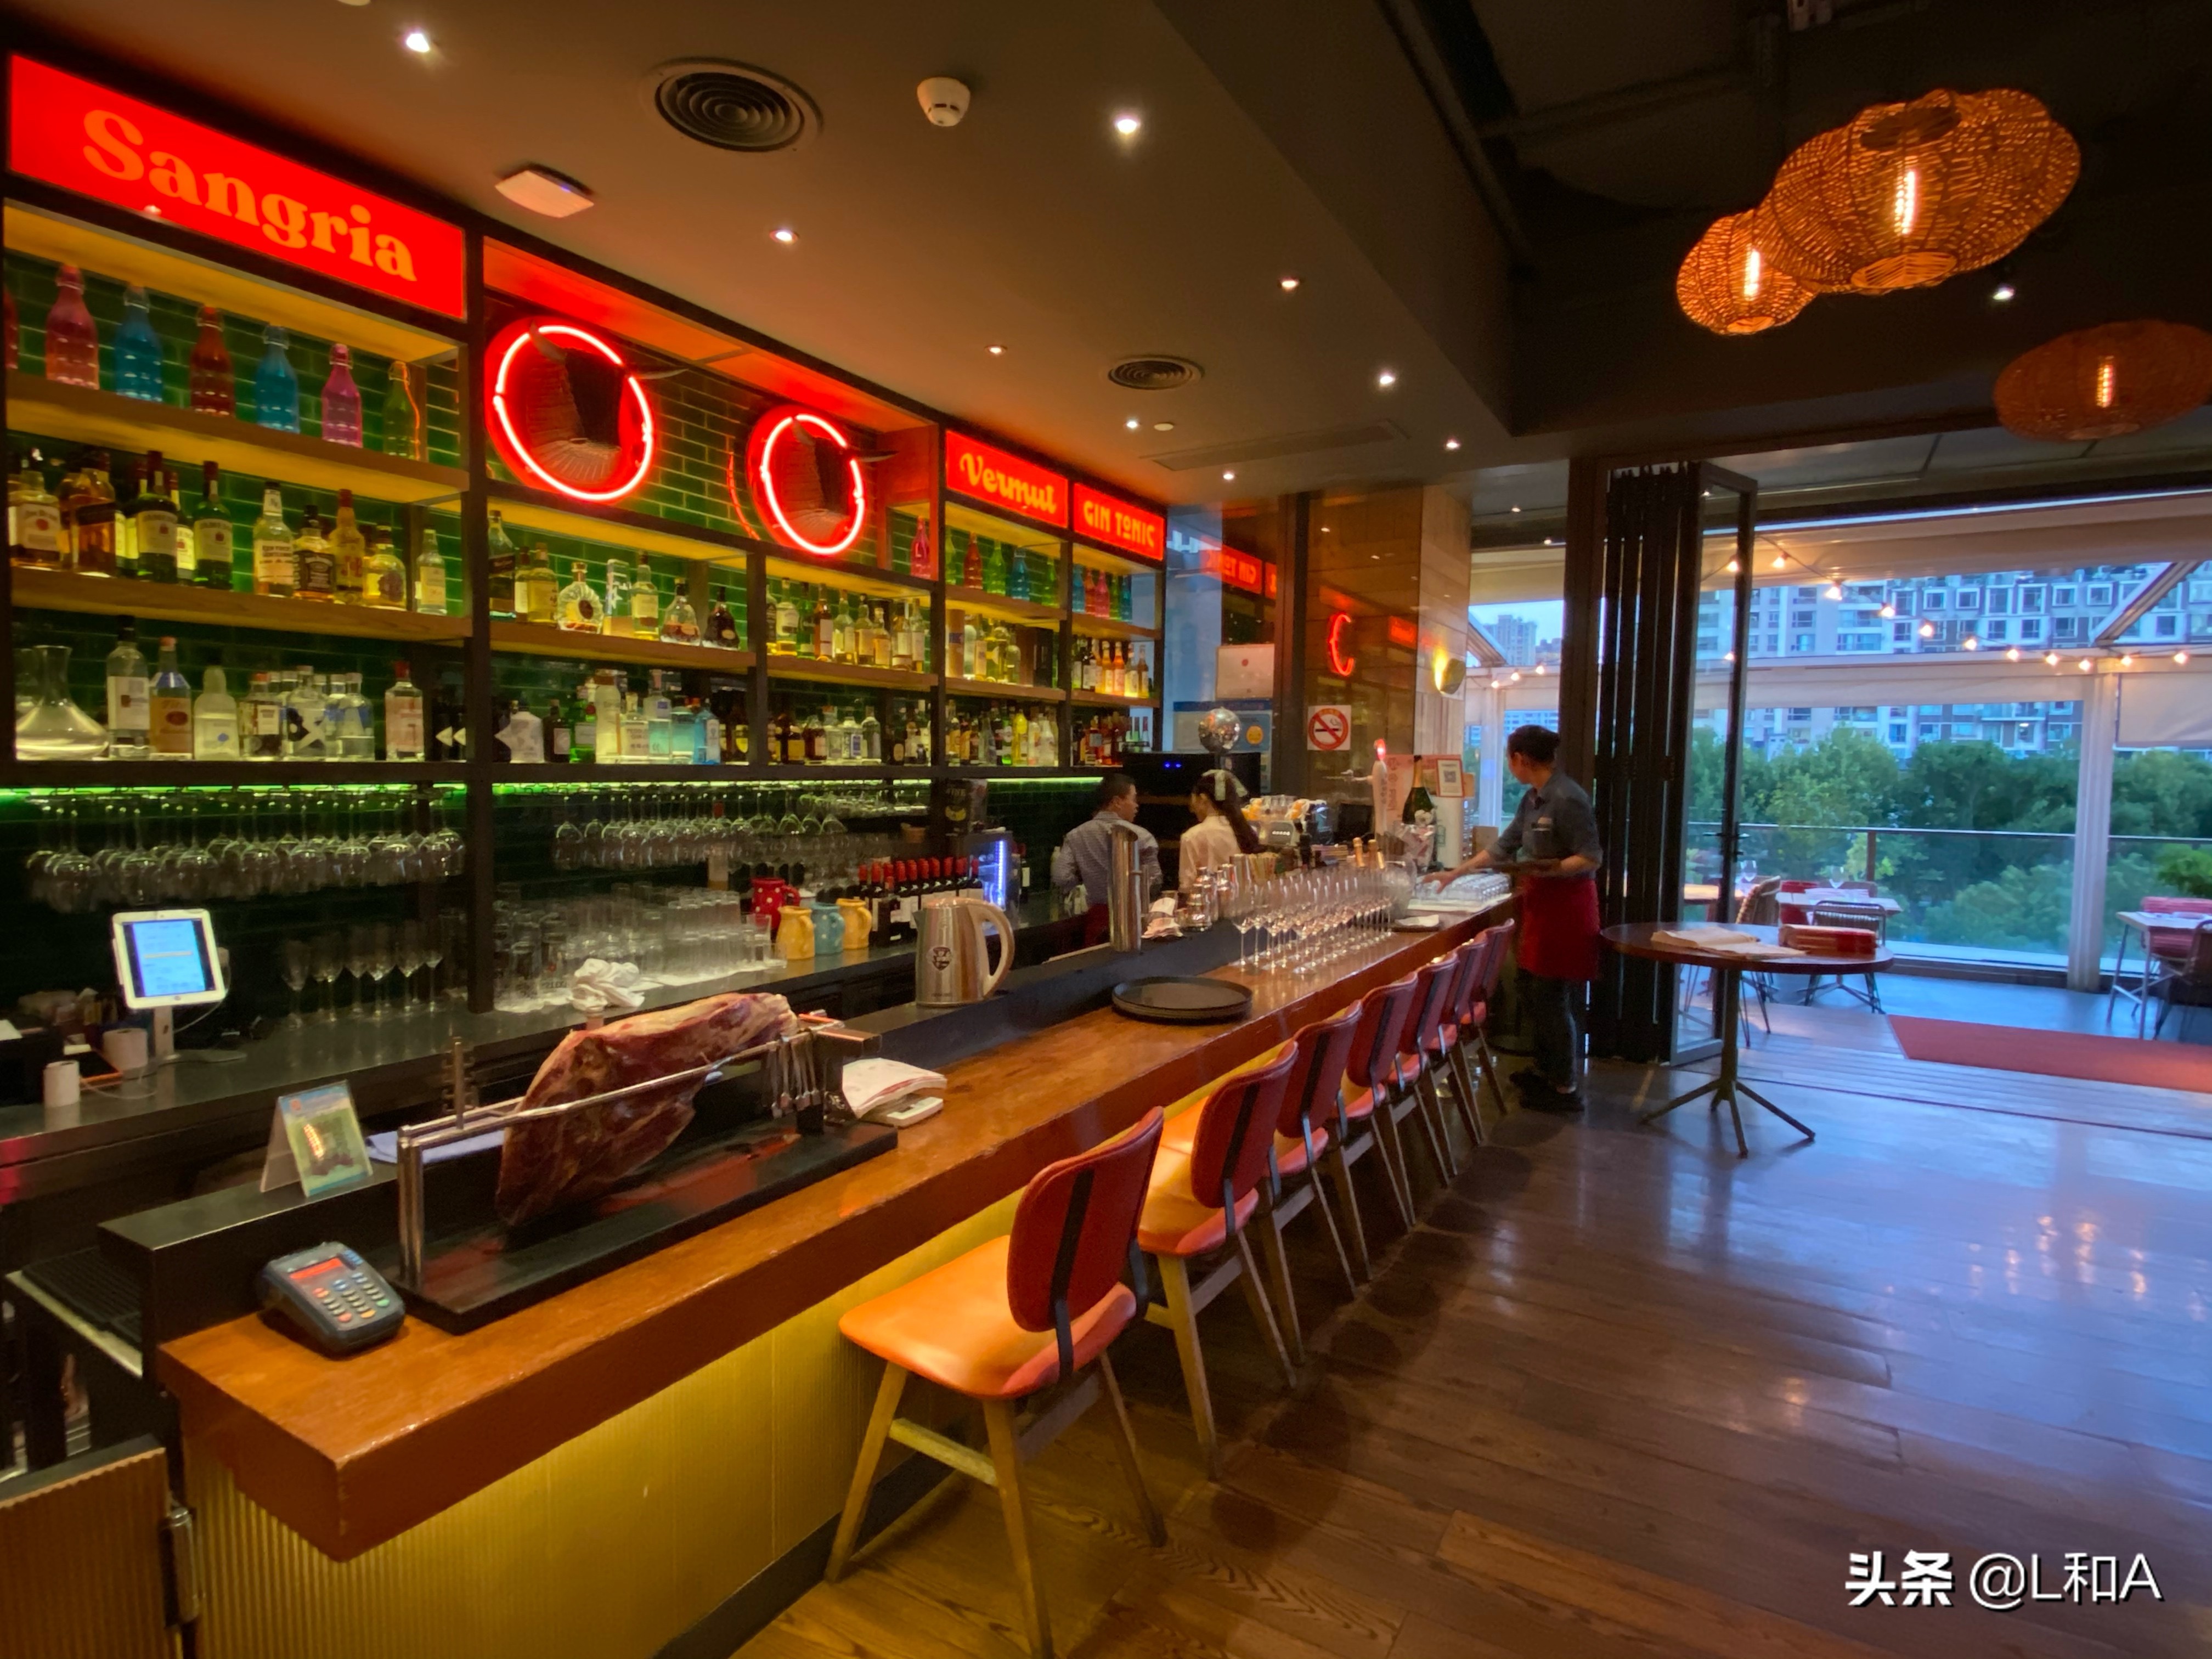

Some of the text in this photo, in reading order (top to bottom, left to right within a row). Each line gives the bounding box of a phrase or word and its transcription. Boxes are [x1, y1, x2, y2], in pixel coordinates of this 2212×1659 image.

[83, 110, 416, 281] Sangria
[960, 453, 1057, 515] Vermut
[1084, 500, 1155, 548] GIN TONIC
